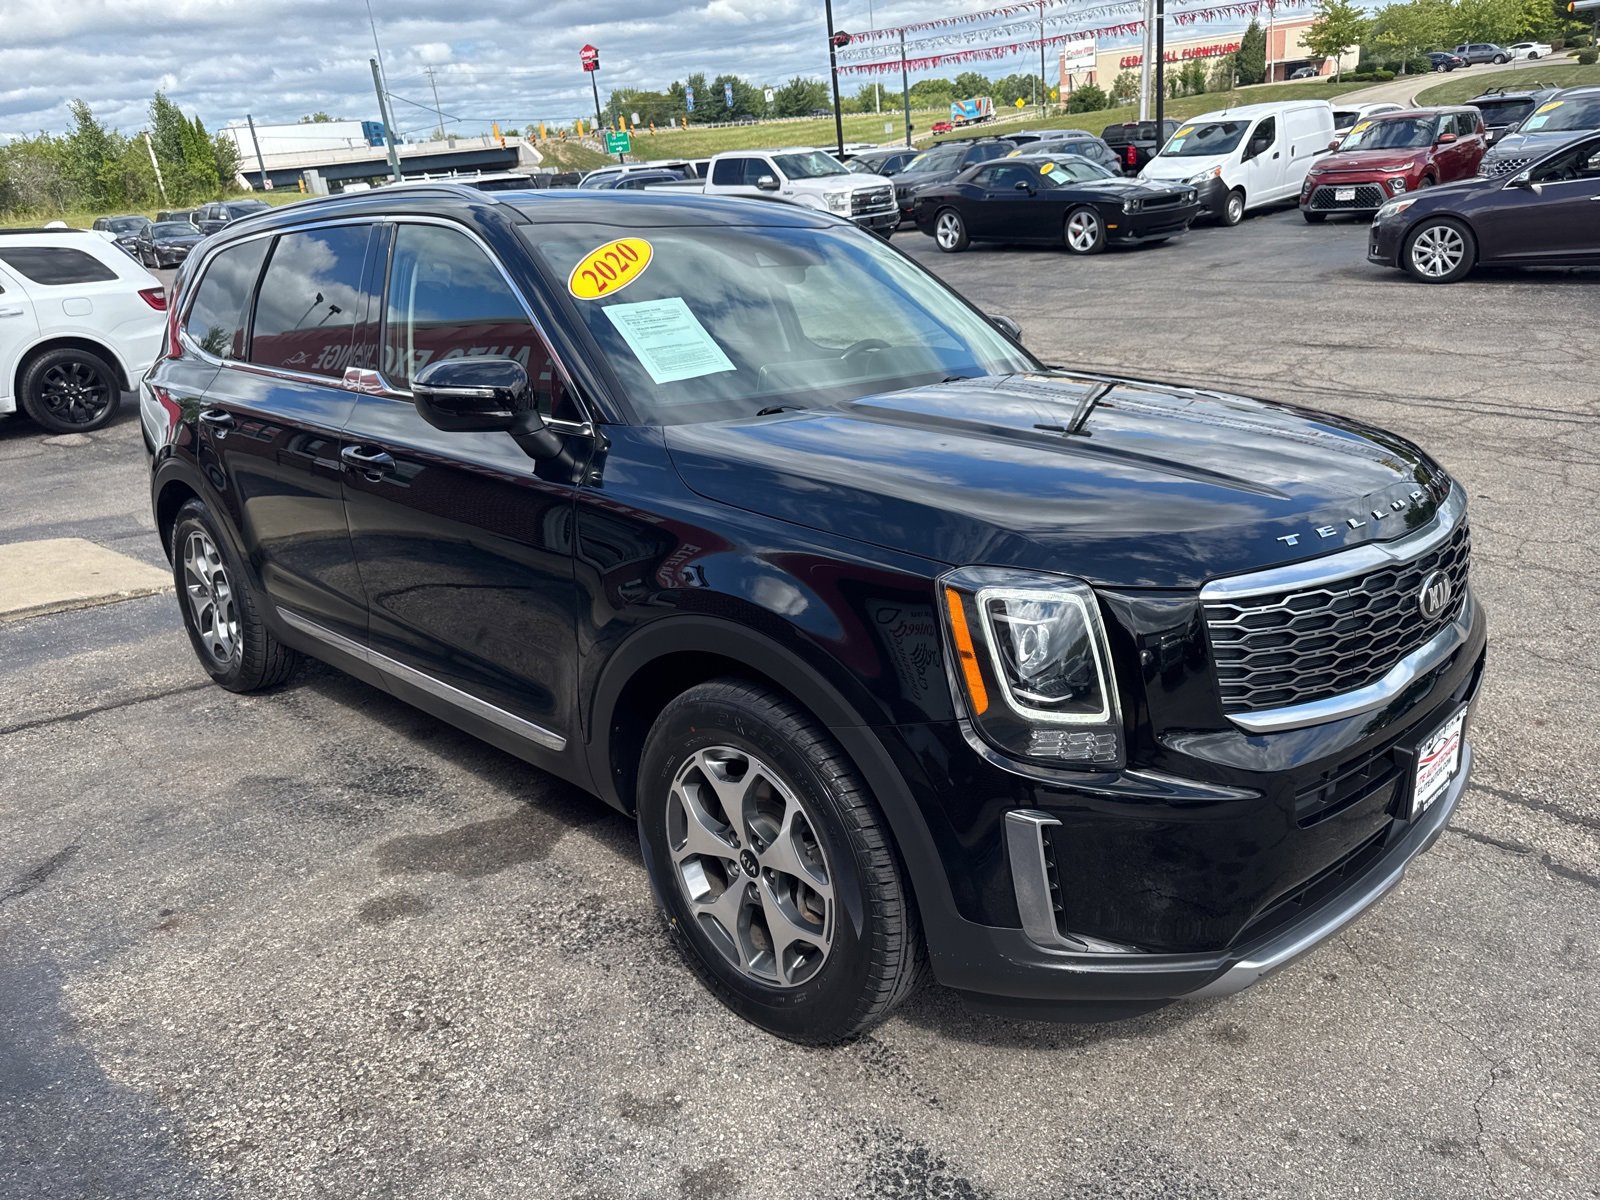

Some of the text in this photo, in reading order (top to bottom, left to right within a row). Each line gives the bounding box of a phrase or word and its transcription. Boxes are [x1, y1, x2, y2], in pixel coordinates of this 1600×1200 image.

[1182, 42, 1241, 60] FURNITURE
[582, 242, 639, 293] 2020
[1428, 578, 1450, 612] KIA
[740, 853, 757, 875] KIA
